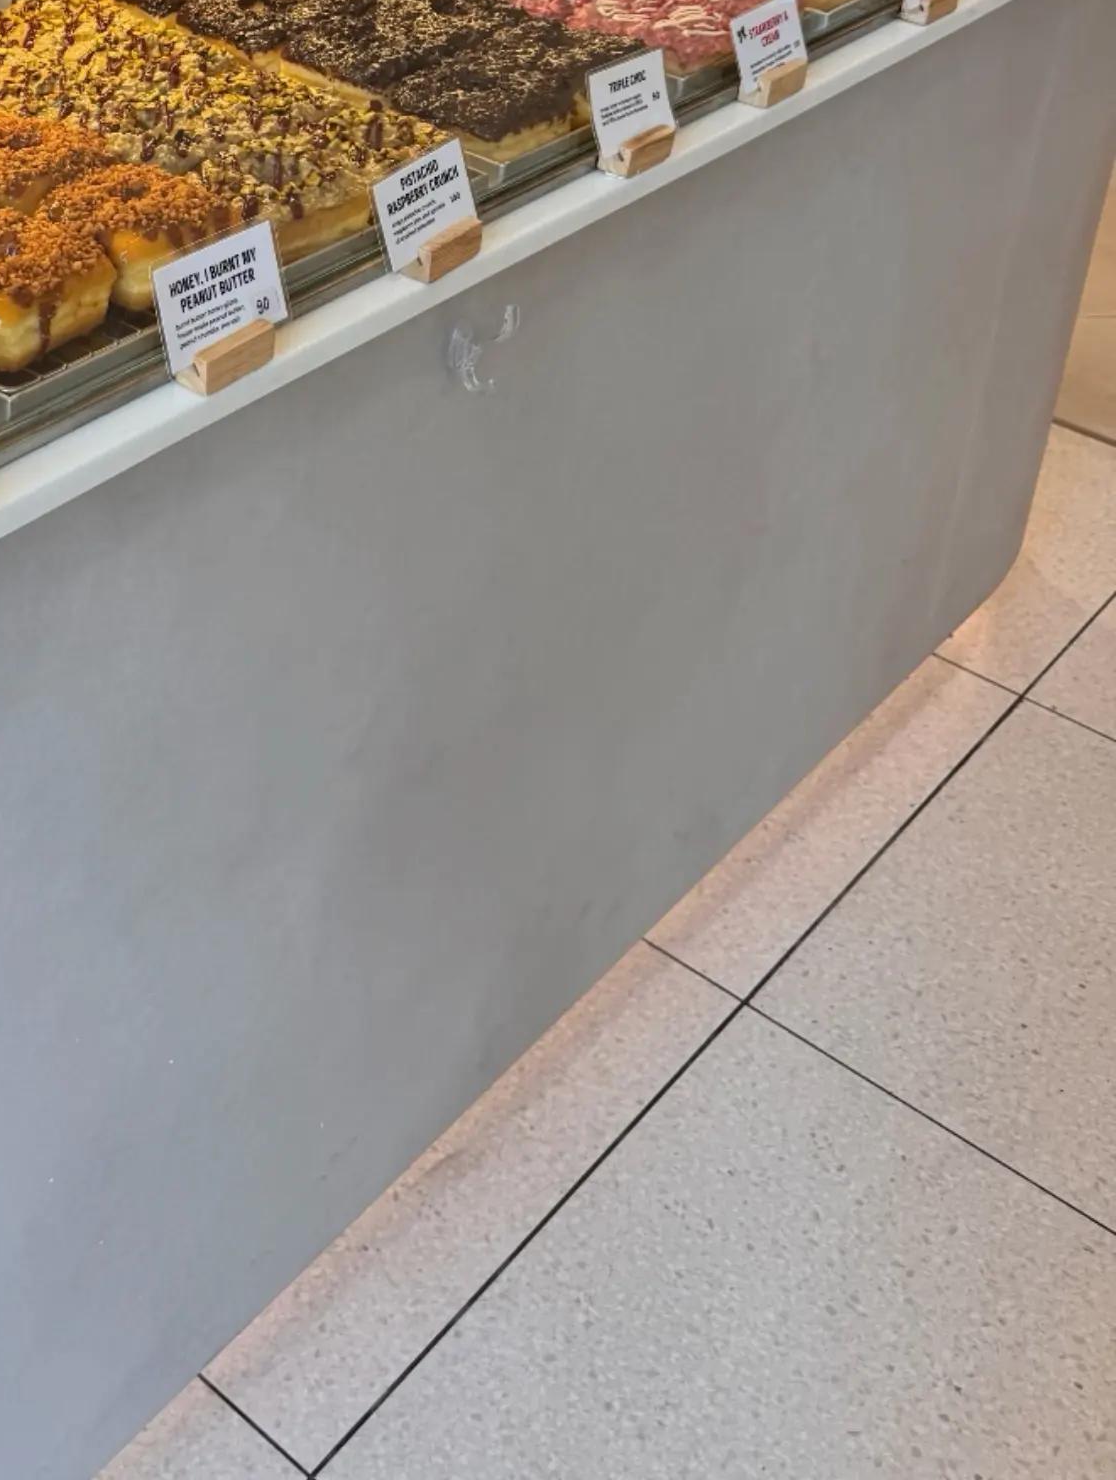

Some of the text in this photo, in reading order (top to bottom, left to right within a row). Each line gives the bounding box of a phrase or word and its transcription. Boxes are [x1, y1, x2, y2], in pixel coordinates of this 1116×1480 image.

[386, 184, 429, 216] RASPBERRY
[429, 165, 460, 191] CRUNCH
[400, 159, 439, 191] PISTACHIO
[209, 254, 241, 278] BURNT
[241, 247, 257, 266] MY
[180, 268, 256, 313] PEANUT BUTTER
